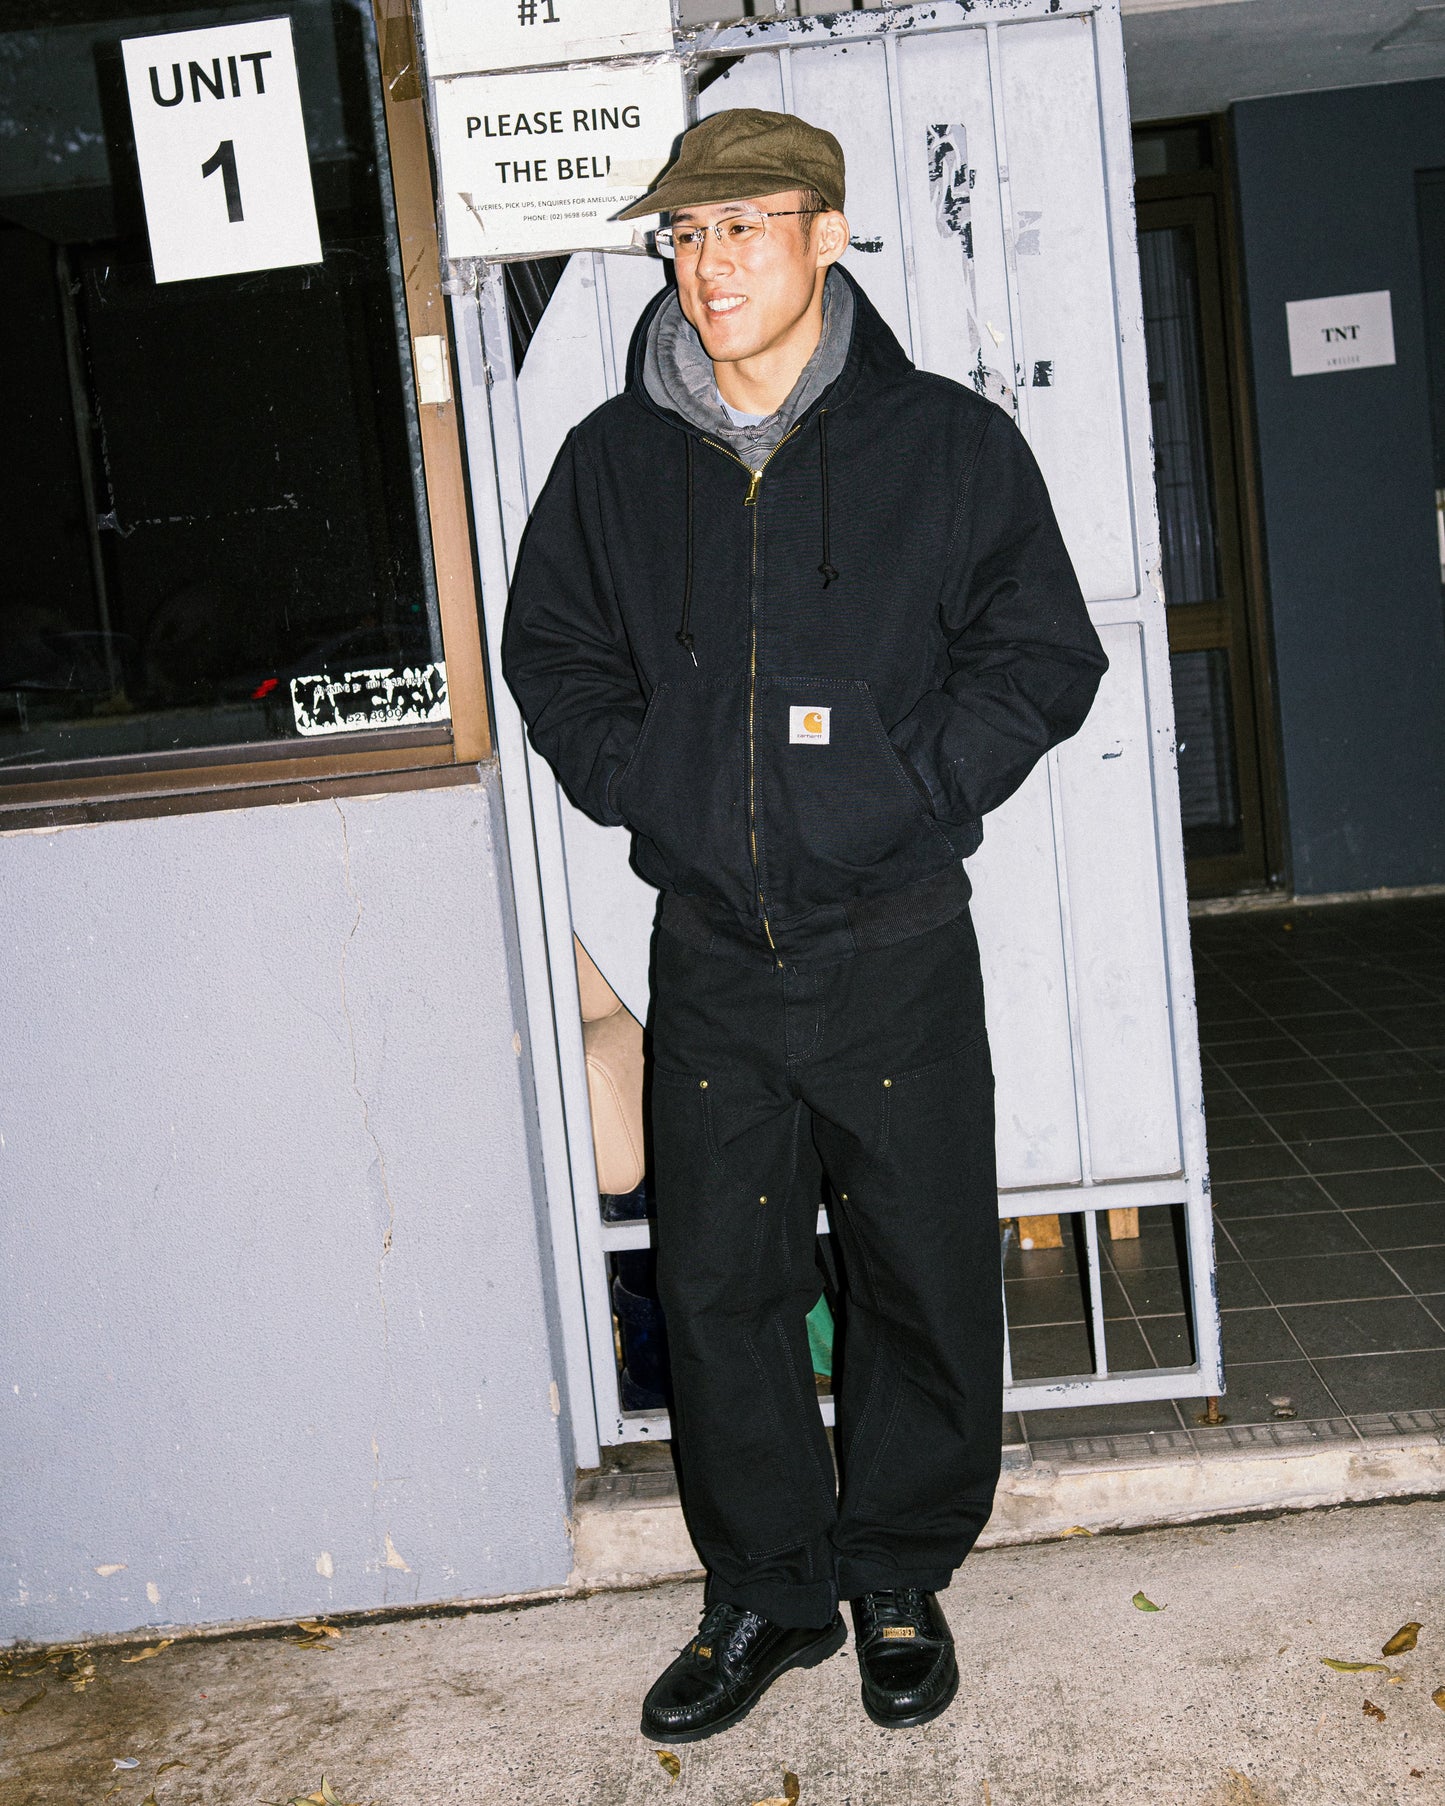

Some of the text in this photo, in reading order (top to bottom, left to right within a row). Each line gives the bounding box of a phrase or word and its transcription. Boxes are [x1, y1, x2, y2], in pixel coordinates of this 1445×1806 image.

[518, 0, 559, 26] #1
[149, 51, 271, 107] UNIT
[467, 106, 639, 138] PLEASE RING
[202, 140, 244, 222] 1
[495, 160, 547, 183] THE
[466, 203, 504, 212] DLIVERIES,
[538, 199, 571, 207] ENQUIRES
[587, 195, 619, 203] AMELIUS,
[523, 214, 549, 222] PHONE:
[549, 212, 563, 221] (02)
[1321, 325, 1361, 343] TNT
